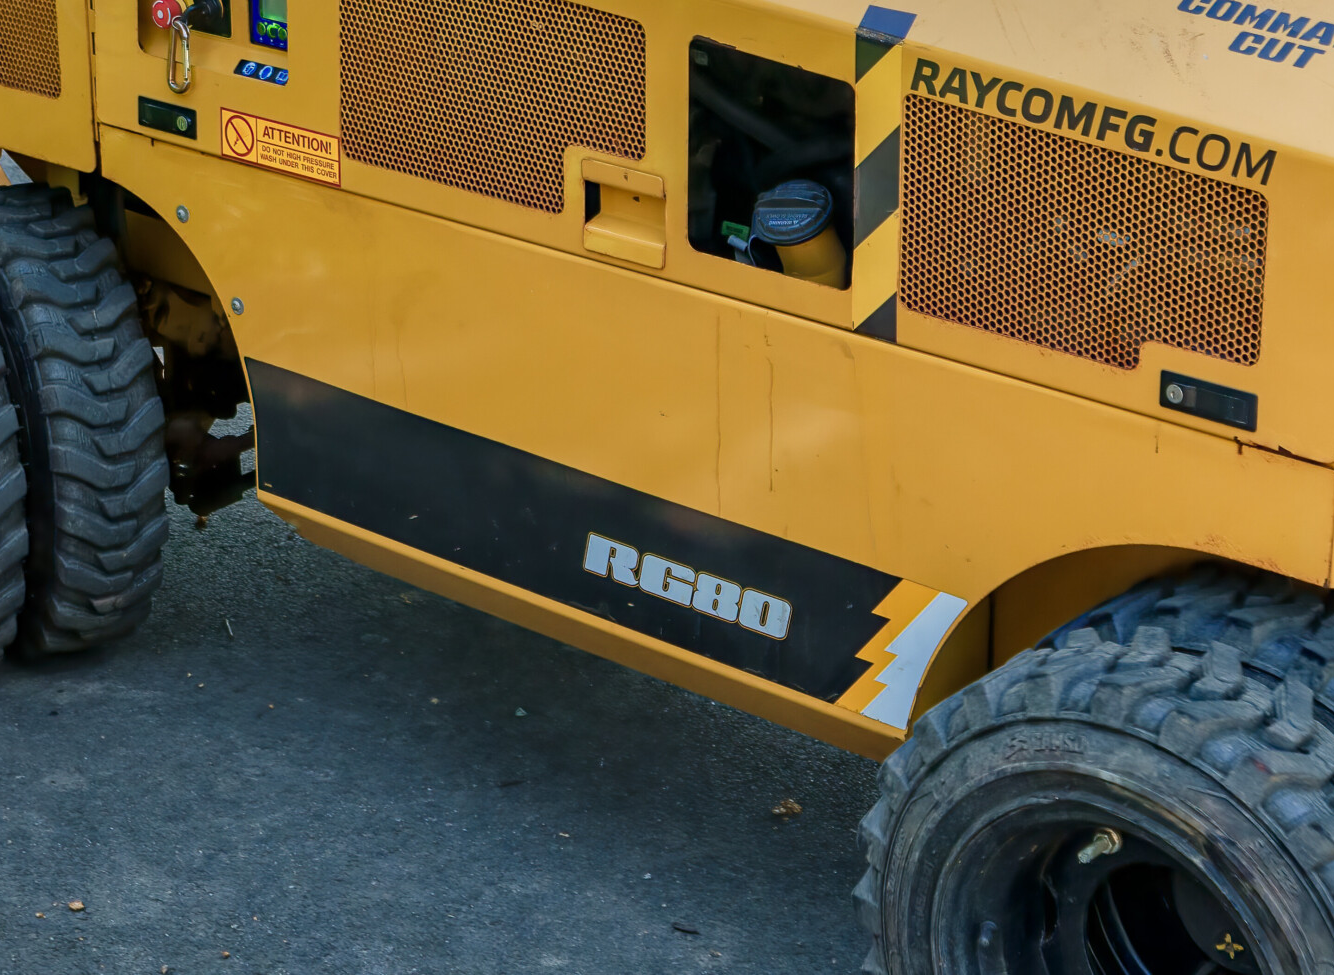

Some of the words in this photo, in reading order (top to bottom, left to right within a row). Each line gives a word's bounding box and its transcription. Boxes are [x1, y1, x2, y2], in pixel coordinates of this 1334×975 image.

[1227, 30, 1326, 69] CUT
[909, 57, 1279, 187] RAYCOMFG.COM
[262, 125, 332, 155] ATTENTION!
[260, 153, 277, 164] WASH
[278, 158, 299, 170] UNDER
[301, 163, 315, 174] THIS
[316, 168, 338, 180] COVER
[261, 145, 271, 153] DO
[272, 147, 285, 157] NOT
[286, 152, 301, 162] HIGH
[302, 155, 335, 170] PRESSURE
[582, 531, 793, 641] RG80
